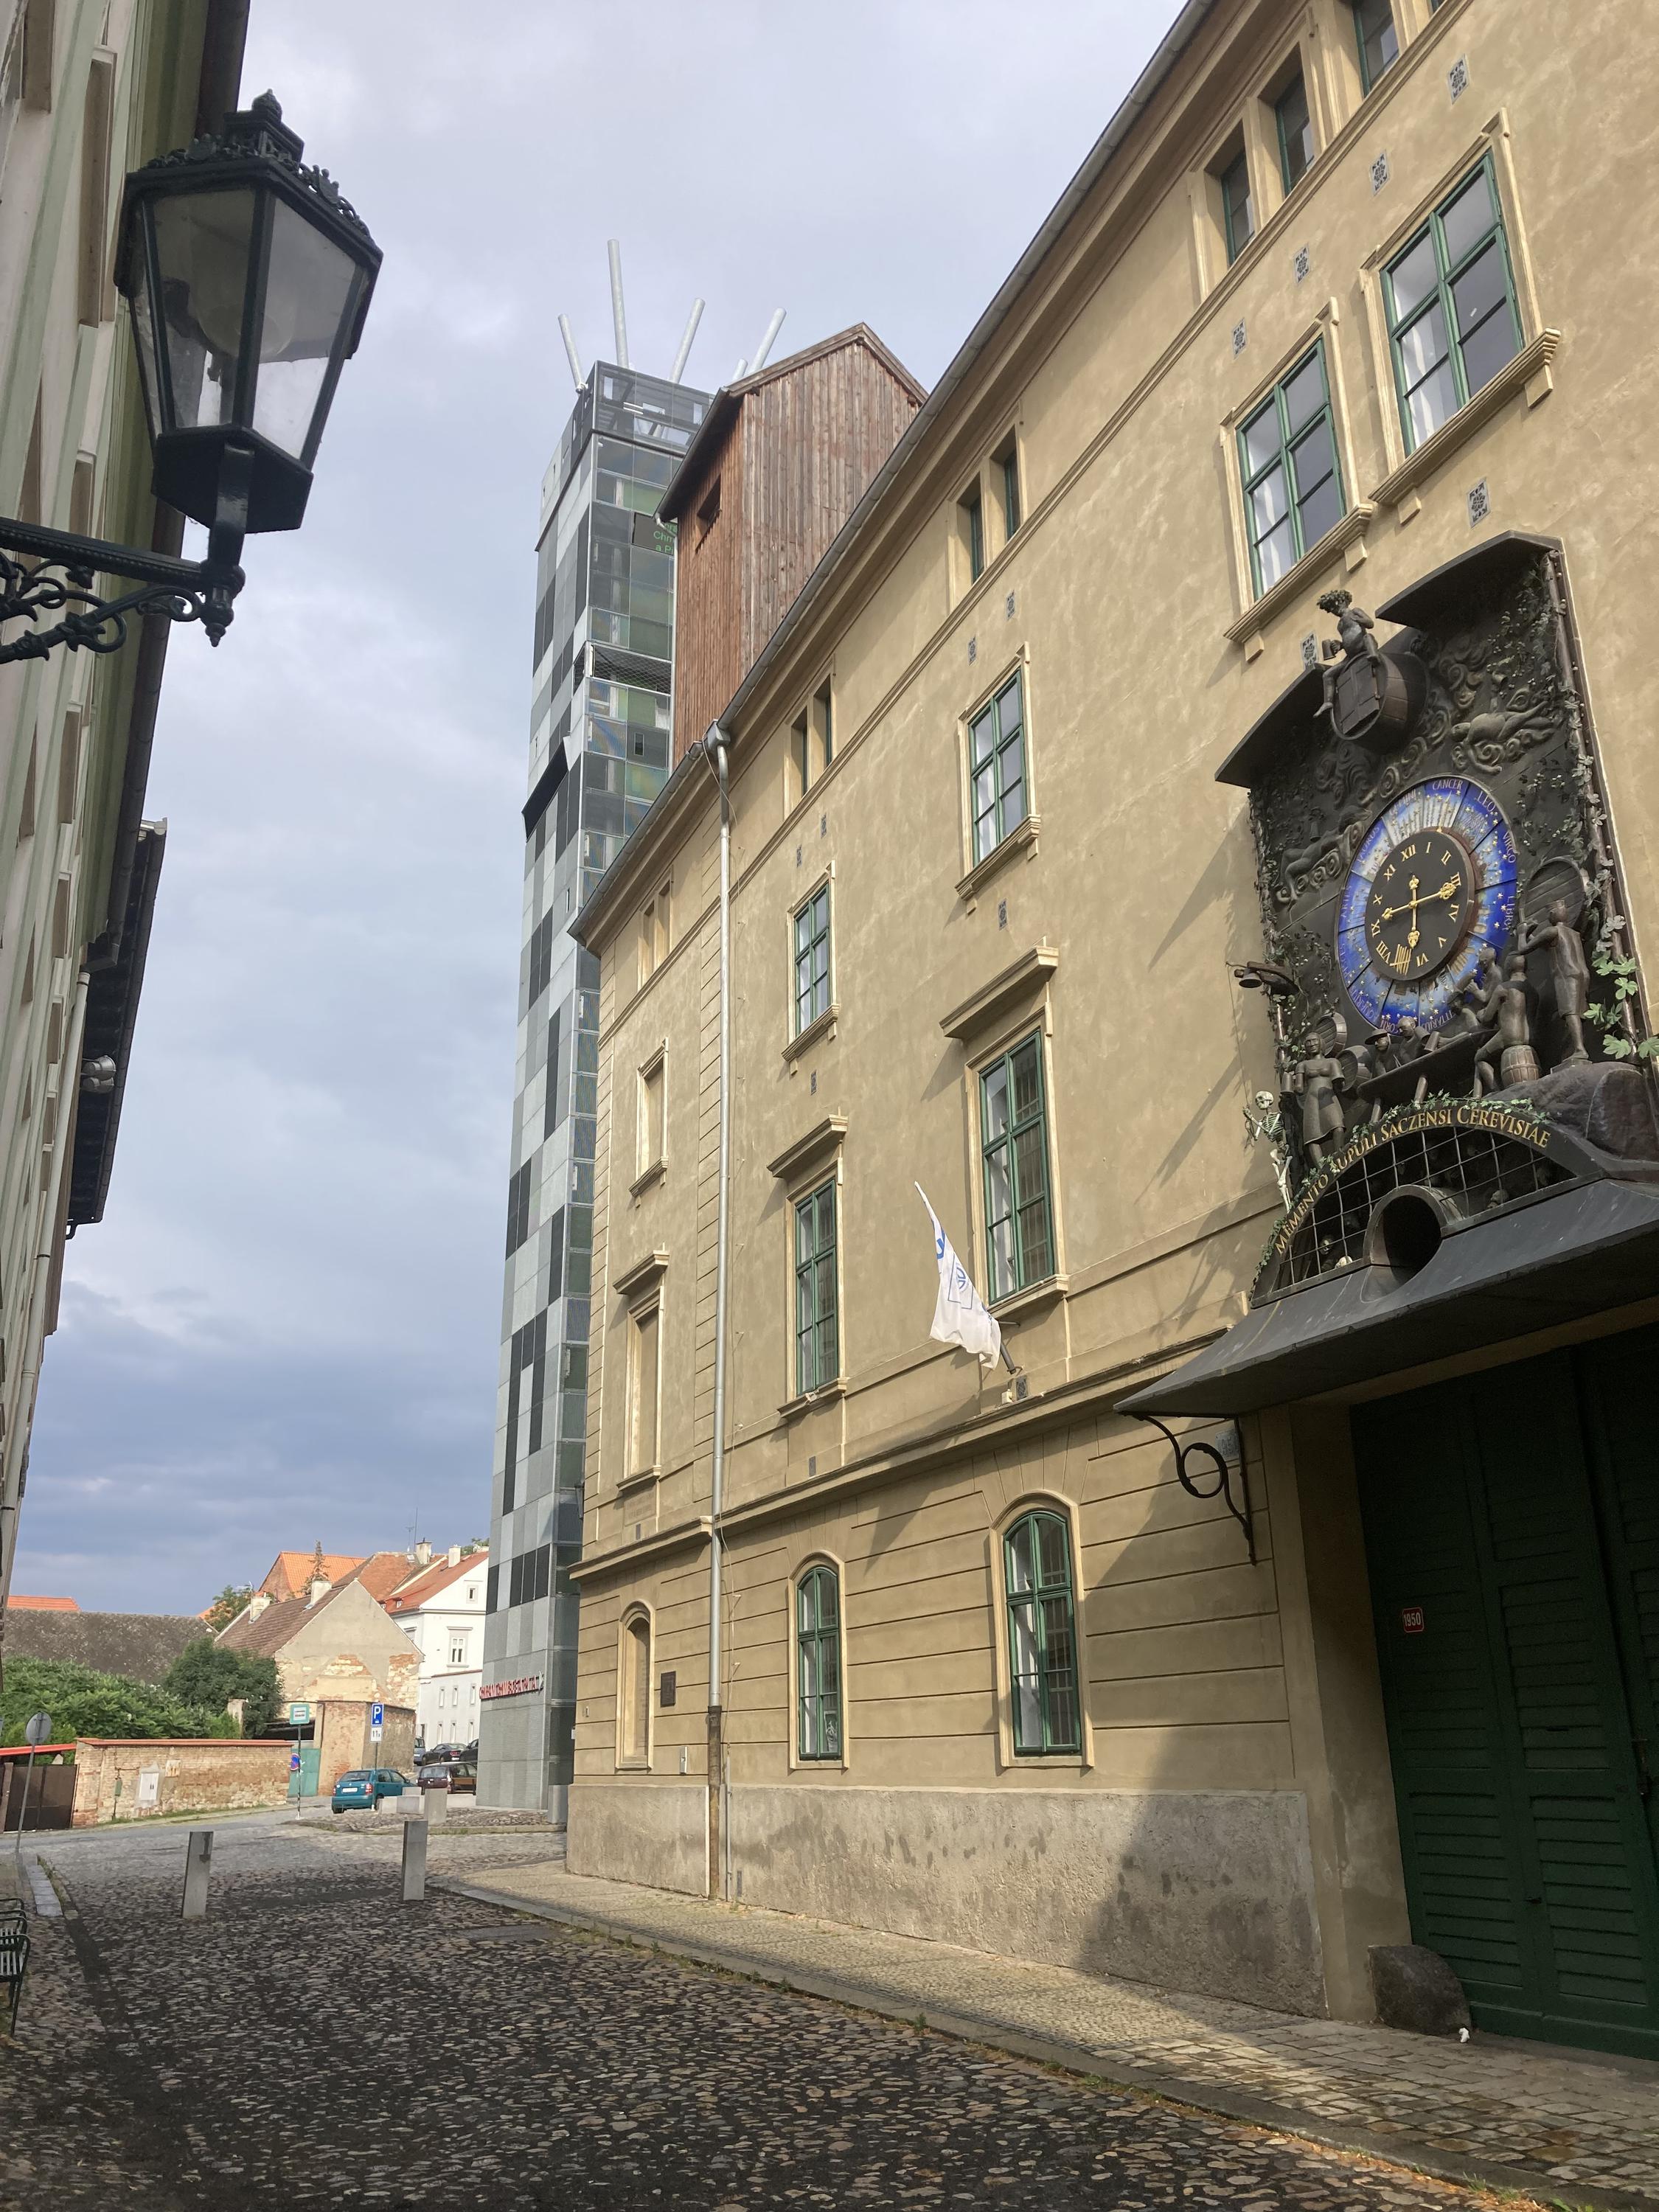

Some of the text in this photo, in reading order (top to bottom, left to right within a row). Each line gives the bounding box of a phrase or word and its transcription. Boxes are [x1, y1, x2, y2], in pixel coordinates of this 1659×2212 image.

[1432, 778, 1464, 794] CANCER
[1476, 790, 1496, 813] LEO
[1400, 844, 1416, 862] XII
[1503, 831, 1517, 863] VIRGO
[1441, 850, 1453, 866] II
[1383, 863, 1397, 881] XI
[1372, 893, 1382, 906] X
[1447, 903, 1460, 923] IV
[1503, 895, 1517, 931] LIBRA
[1371, 919, 1382, 938] IX
[1438, 936, 1447, 949] V
[1375, 940, 1393, 965] VIII
[1416, 953, 1429, 967] VI
[1275, 1107, 1551, 1256] MEMENTO UPULI SACZENSI CEREVISIAE
[1404, 1612, 1422, 1627] 1950
[373, 1705, 381, 1719] P
